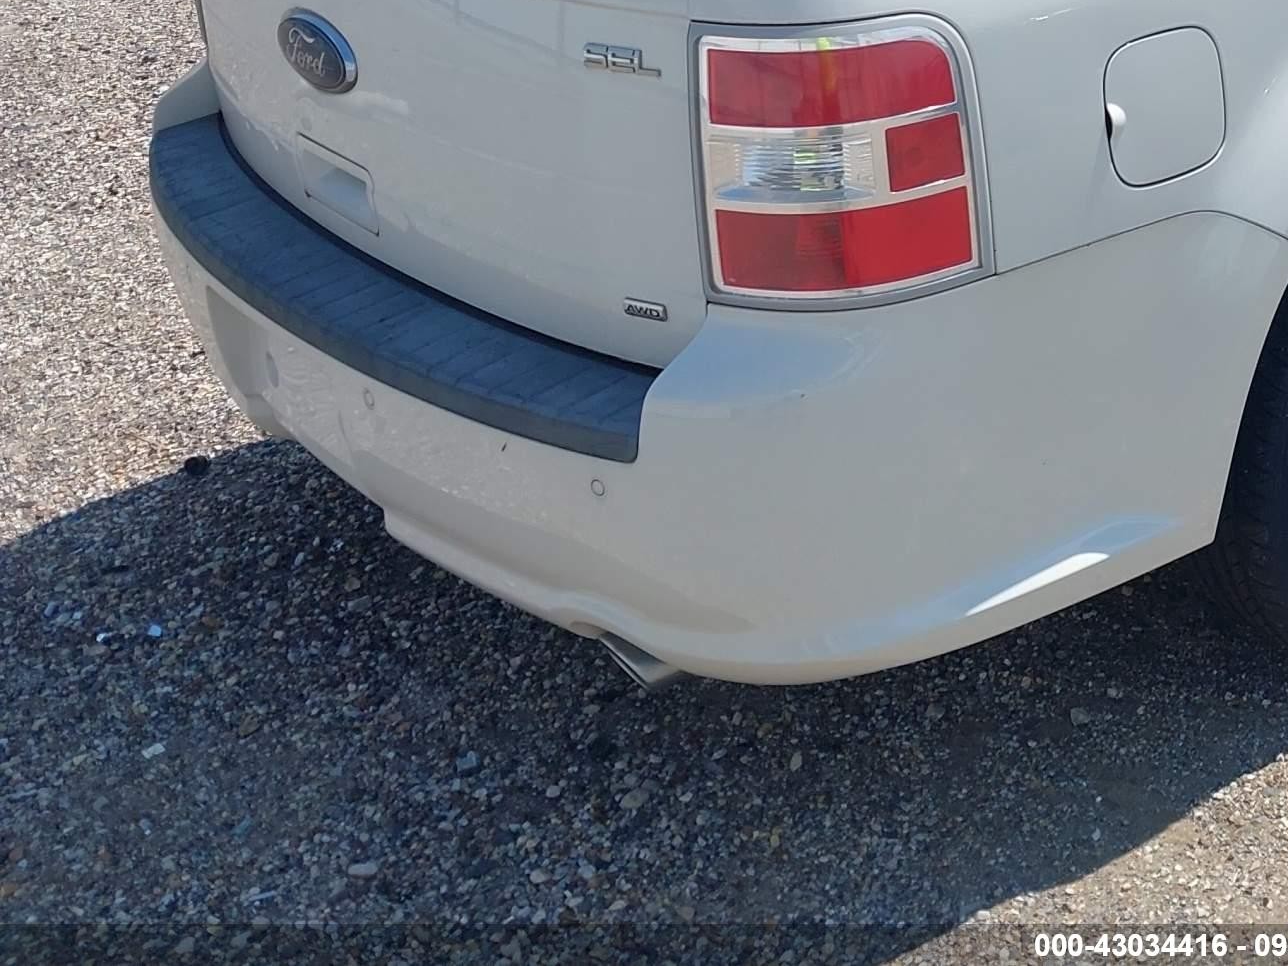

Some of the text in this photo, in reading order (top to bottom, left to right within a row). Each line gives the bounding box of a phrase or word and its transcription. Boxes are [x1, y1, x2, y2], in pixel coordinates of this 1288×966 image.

[286, 27, 326, 77] Ford
[583, 44, 662, 76] SEL
[624, 302, 662, 319] AWD
